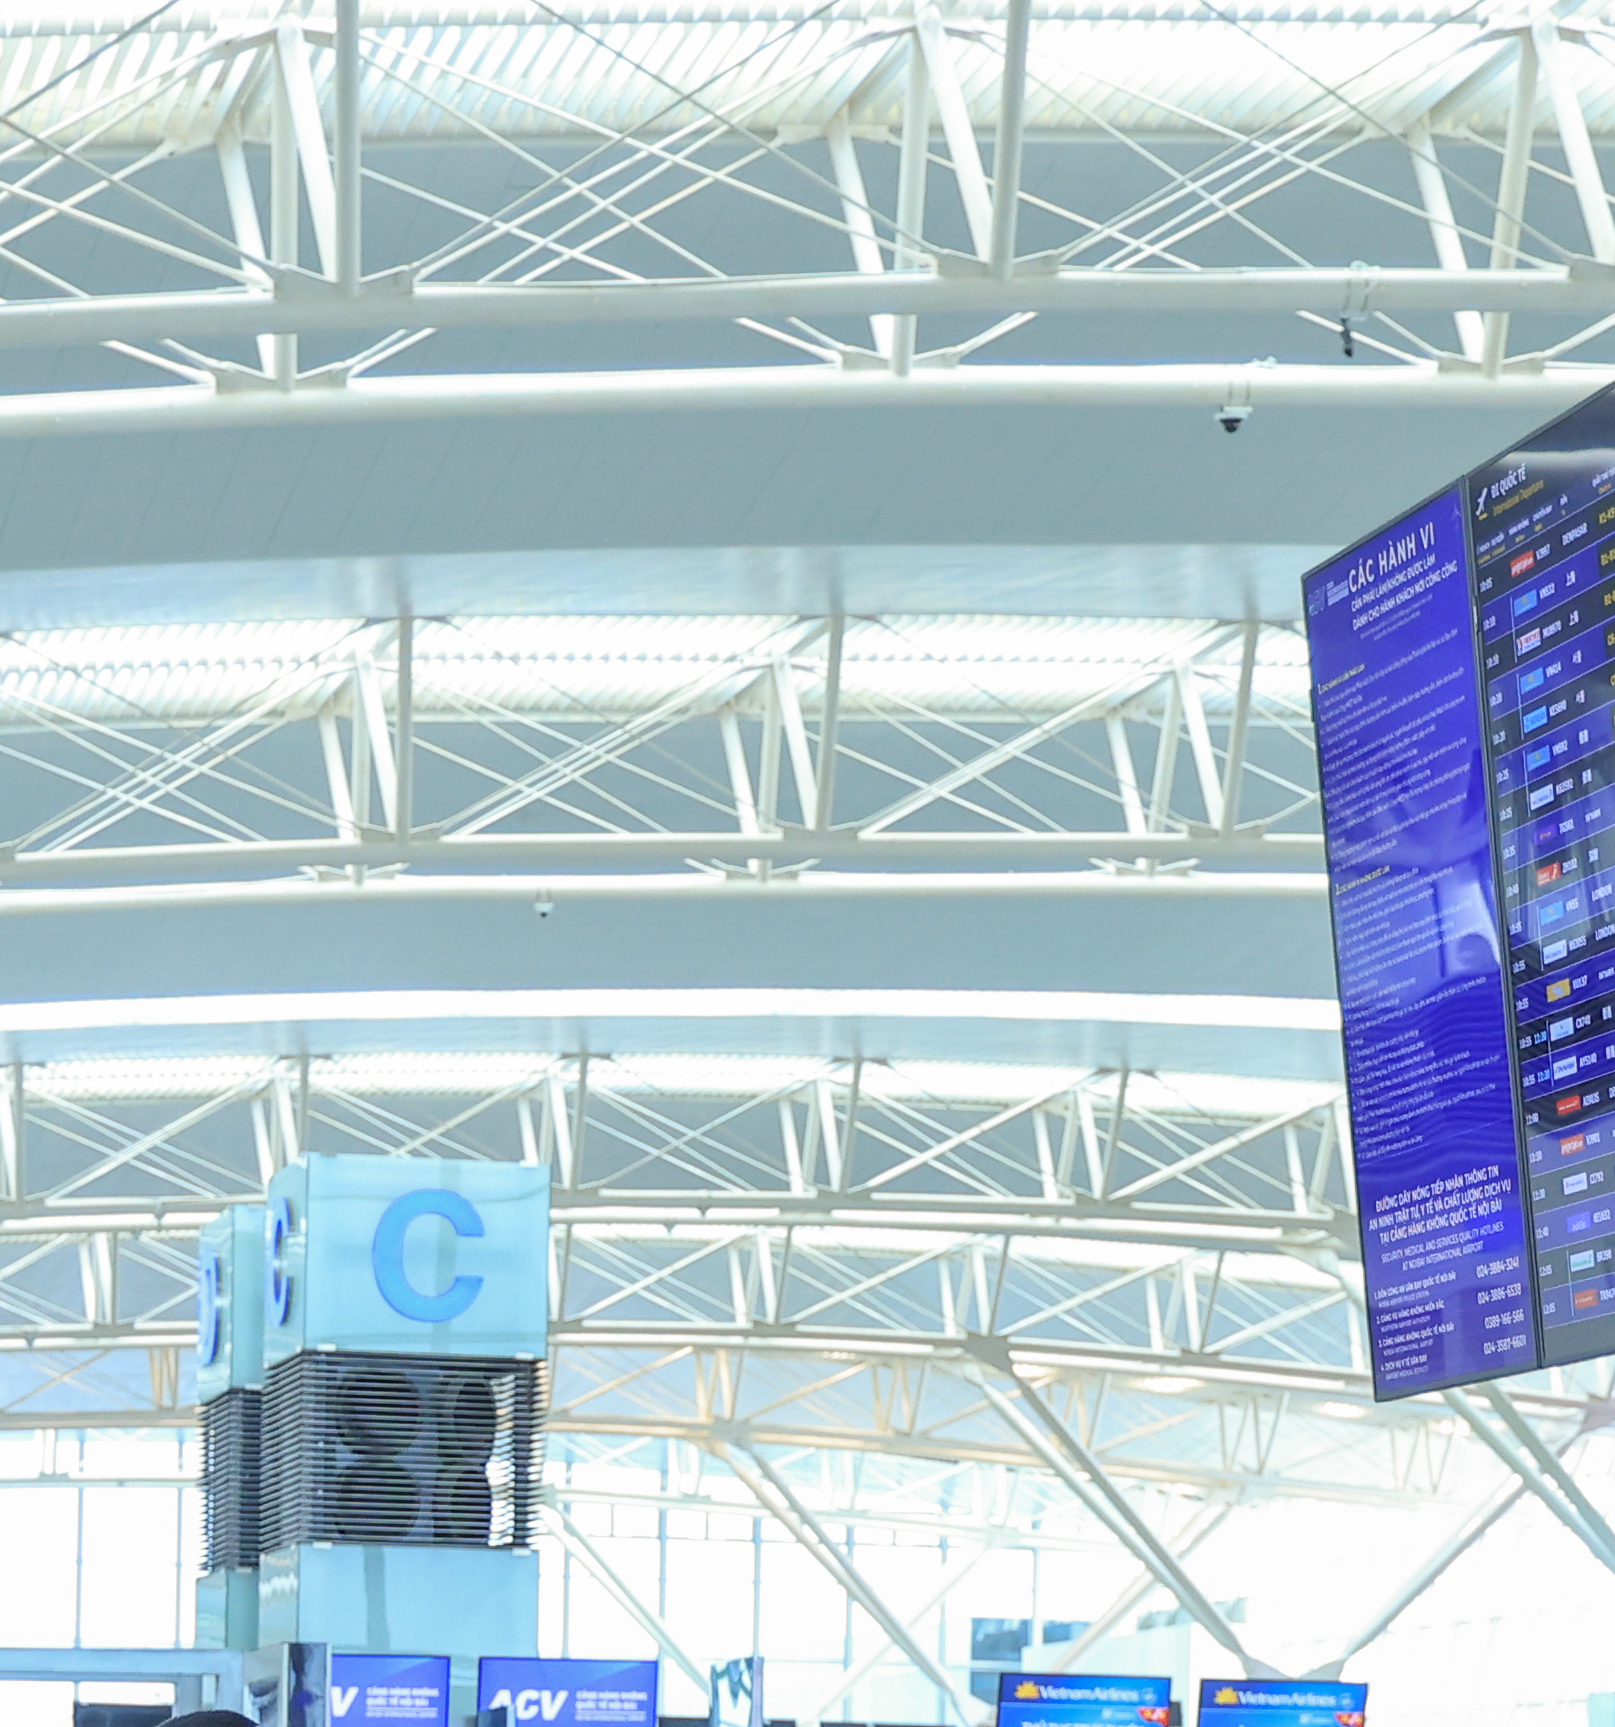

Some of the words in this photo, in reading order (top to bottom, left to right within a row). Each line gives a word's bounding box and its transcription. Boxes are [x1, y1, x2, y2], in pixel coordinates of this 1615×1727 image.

[1349, 558, 1375, 592] CÁC
[1378, 533, 1416, 576] HÀNH
[1420, 522, 1435, 549] VI
[1488, 1165, 1499, 1179] TIN
[372, 1189, 485, 1322] C
[488, 1689, 569, 1721] ACV
